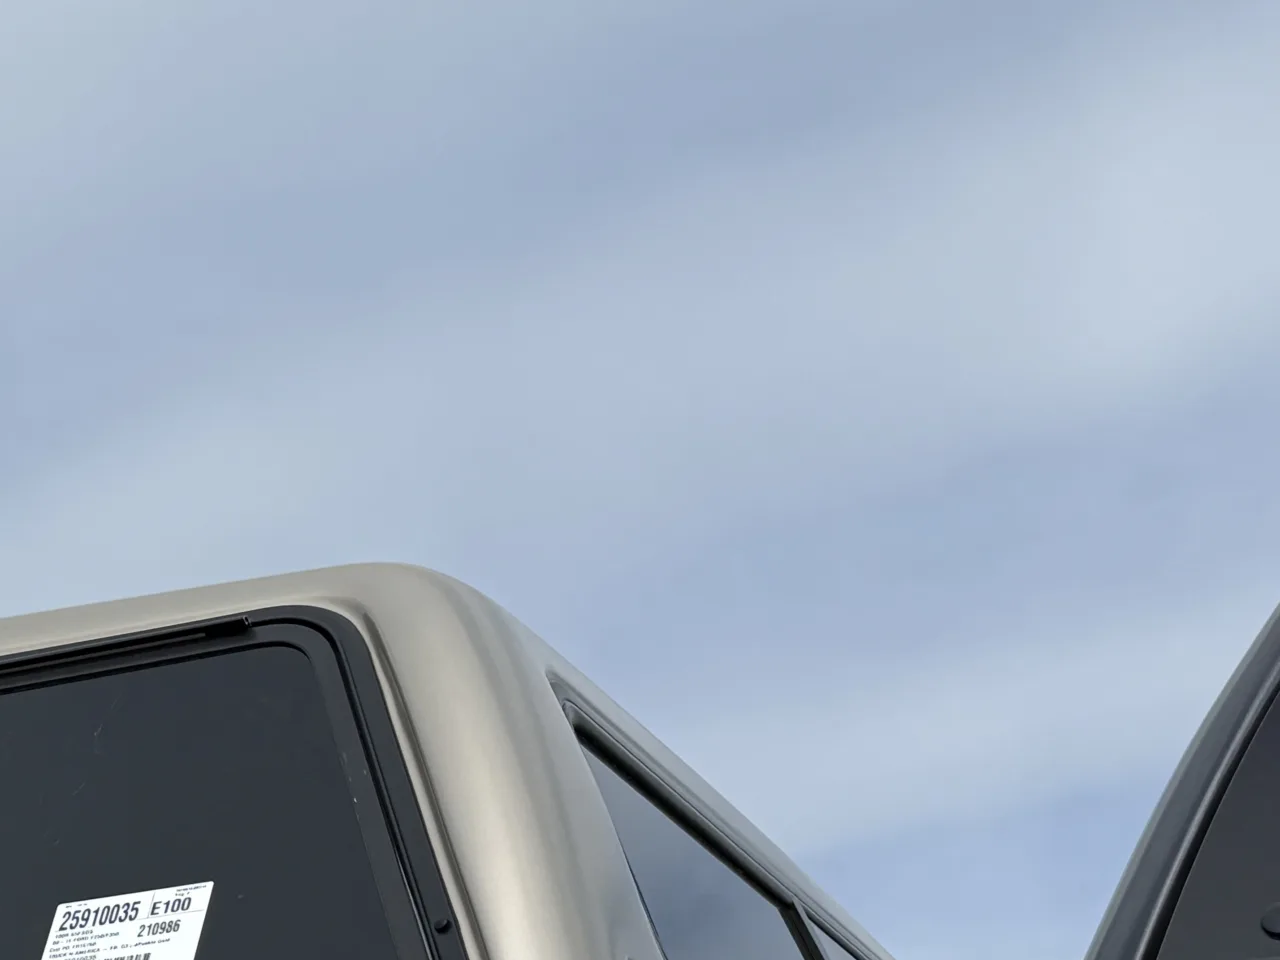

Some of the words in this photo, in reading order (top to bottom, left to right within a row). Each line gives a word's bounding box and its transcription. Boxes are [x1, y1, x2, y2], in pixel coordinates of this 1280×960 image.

[58, 901, 141, 932] 25910035
[150, 897, 192, 916] E100
[137, 919, 182, 938] 210986
